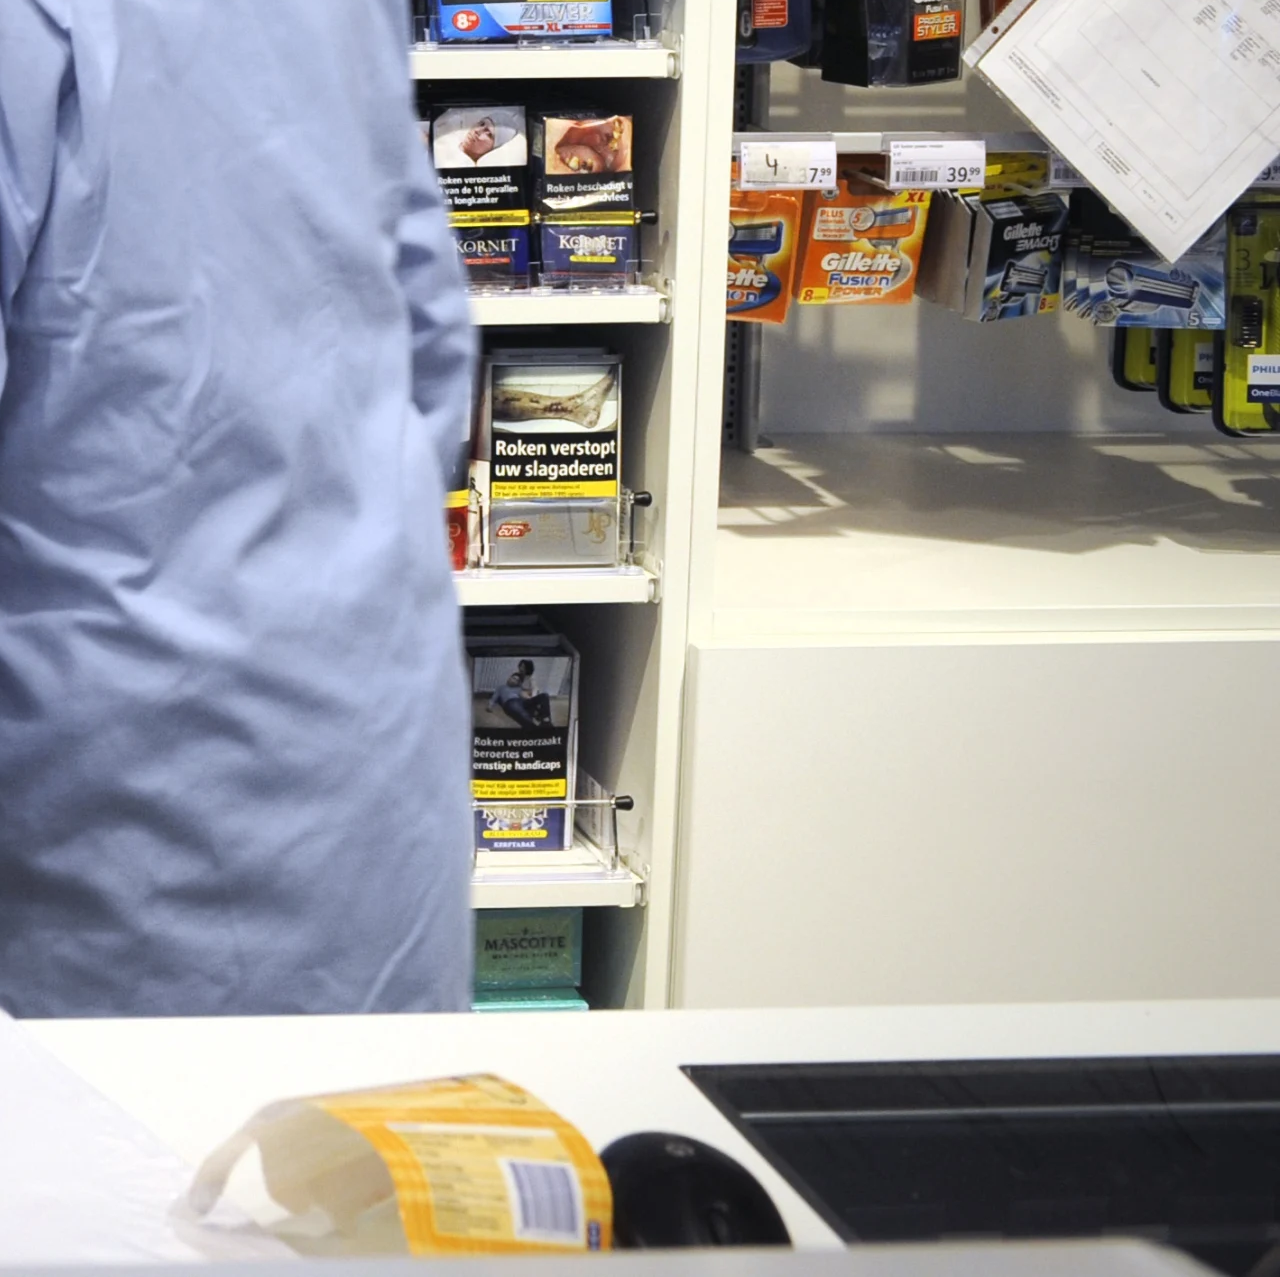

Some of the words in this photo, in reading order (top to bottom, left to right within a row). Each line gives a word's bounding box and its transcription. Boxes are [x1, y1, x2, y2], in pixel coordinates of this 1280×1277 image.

[520, 3, 595, 21] ZILVER
[546, 22, 561, 32] XL
[917, 23, 958, 36] STYLER
[946, 167, 981, 183] 39.99
[904, 191, 927, 203] XL
[820, 210, 844, 219] PLUS
[1003, 223, 1043, 241] Gillette
[456, 238, 519, 253] KORNET
[559, 235, 627, 251] KORNET
[821, 252, 902, 273] Gillette
[827, 273, 890, 287] Fusion
[803, 288, 814, 302] 8
[832, 286, 884, 297] POWER
[495, 439, 547, 456] Roken
[550, 439, 616, 459] verstopt
[494, 464, 521, 477] uw
[525, 460, 614, 481] slagaderen
[473, 760, 512, 773] ernstige
[514, 759, 561, 772] handicaps
[484, 935, 567, 952] MASCOTTE
